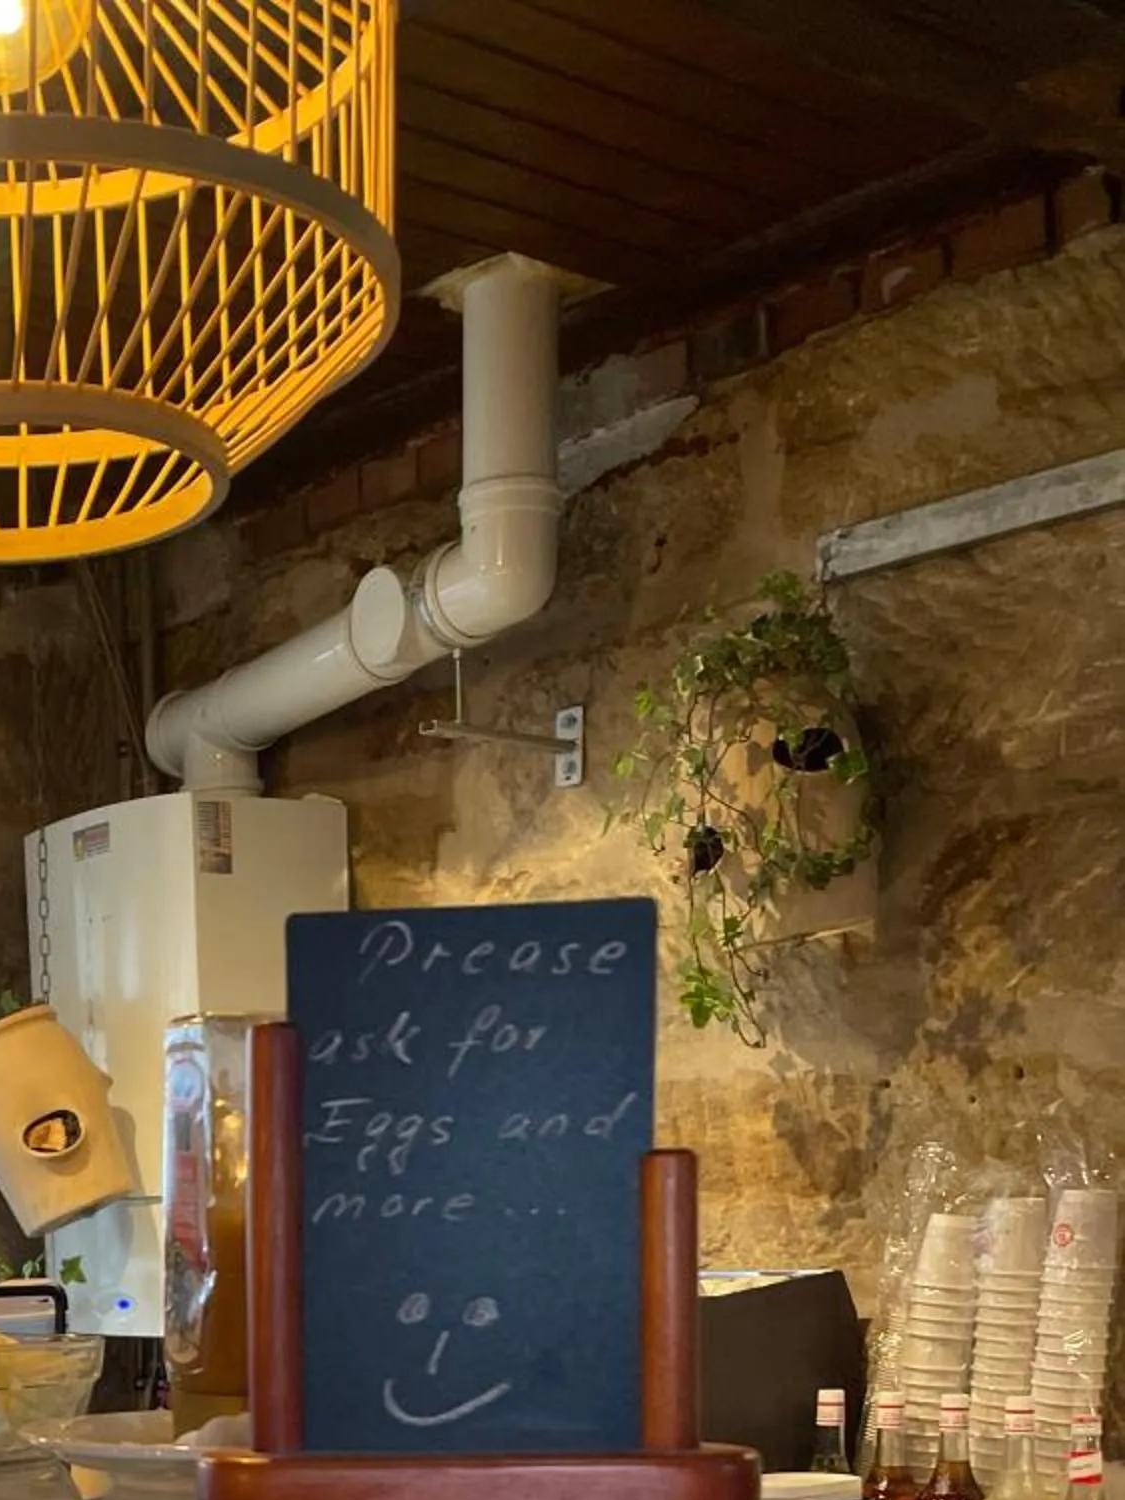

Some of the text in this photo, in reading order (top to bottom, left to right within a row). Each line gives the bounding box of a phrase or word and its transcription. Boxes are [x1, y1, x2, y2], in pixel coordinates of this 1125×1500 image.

[308, 1004, 547, 1078] ask for
[303, 1091, 637, 1176] Eggs and
